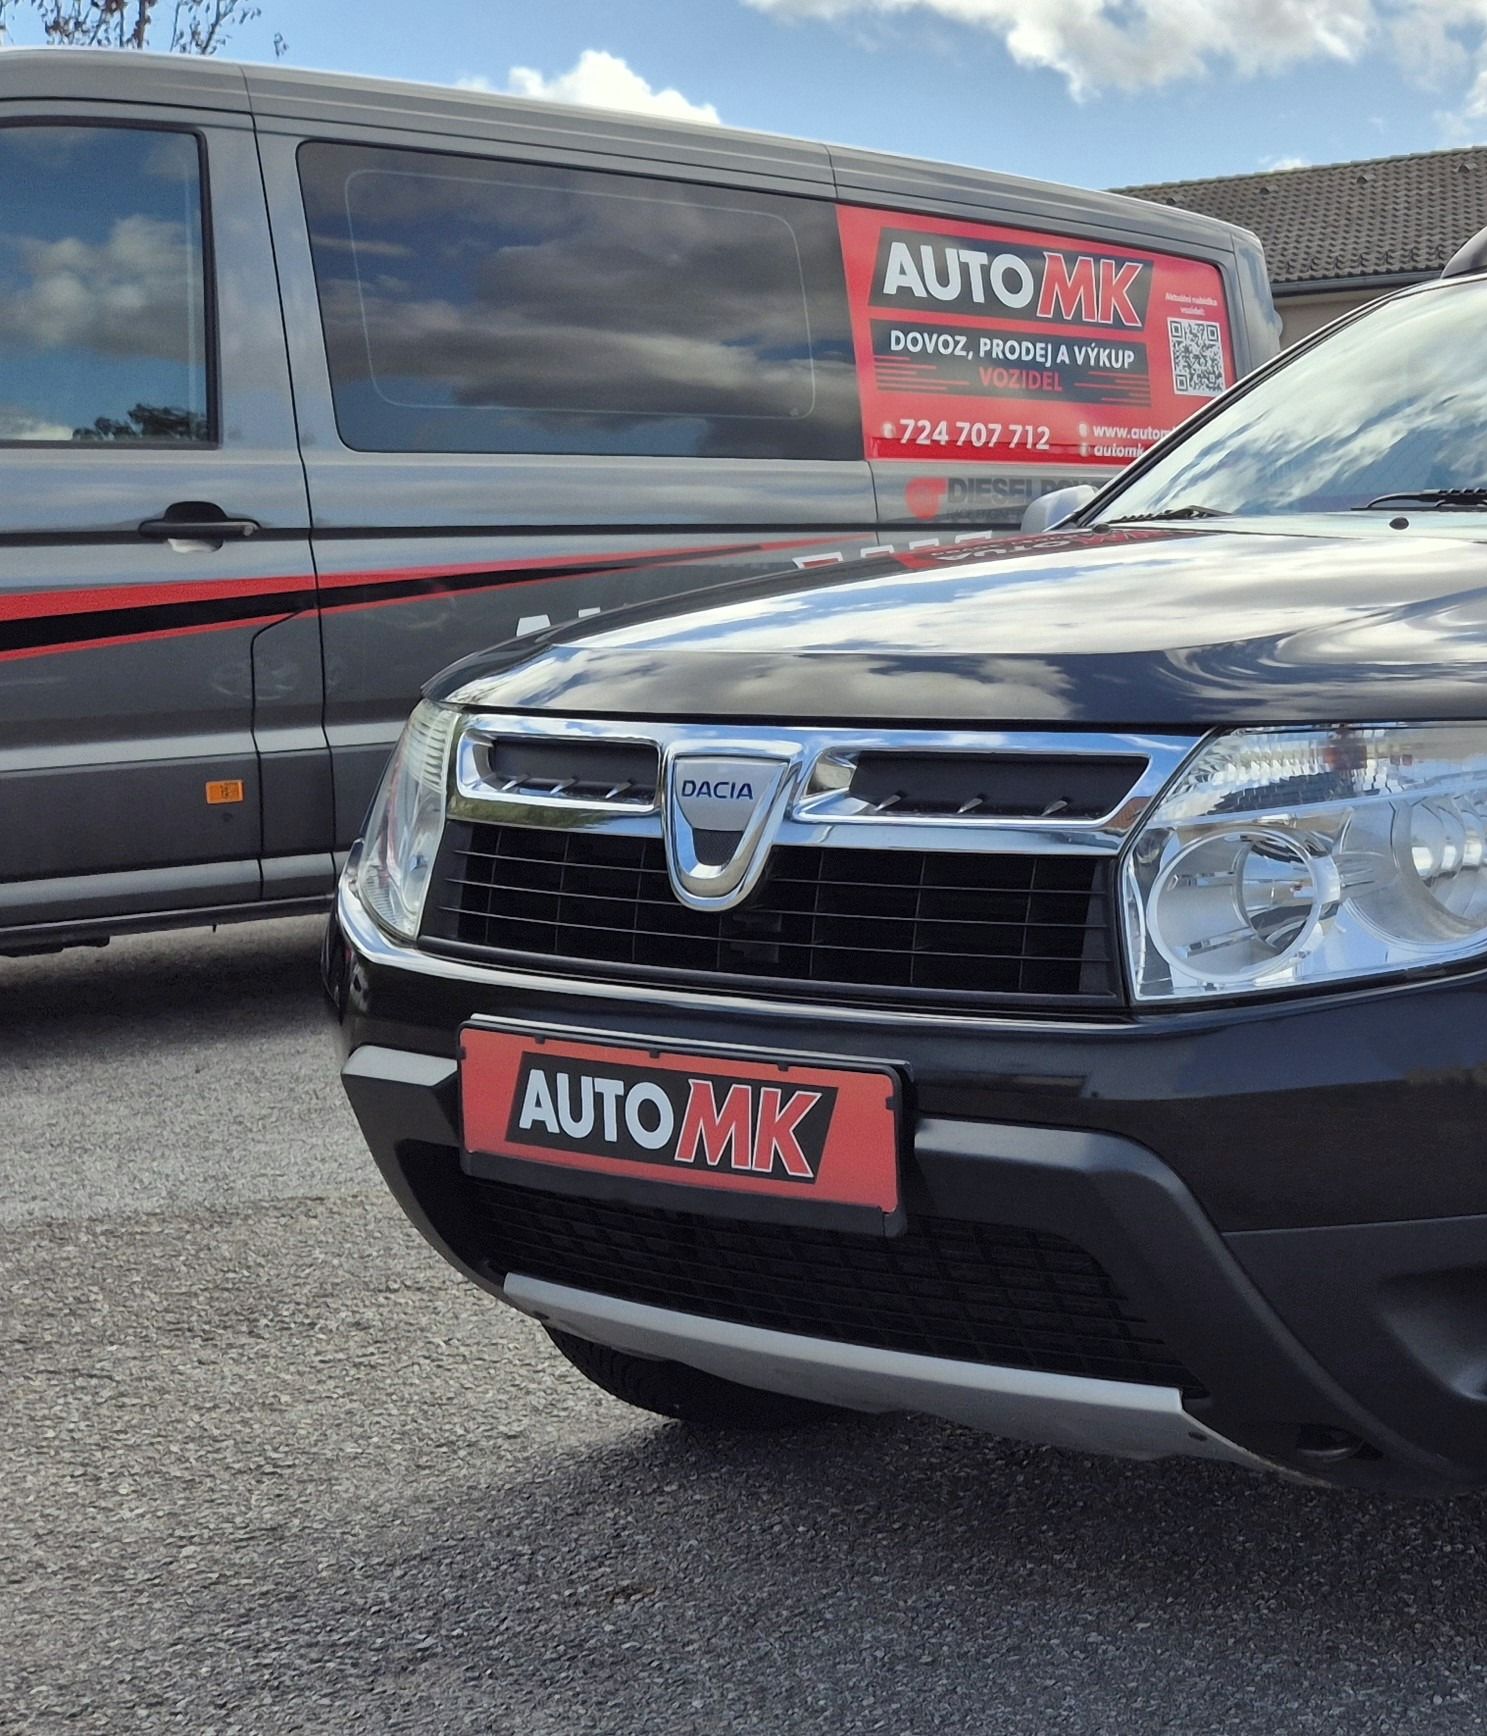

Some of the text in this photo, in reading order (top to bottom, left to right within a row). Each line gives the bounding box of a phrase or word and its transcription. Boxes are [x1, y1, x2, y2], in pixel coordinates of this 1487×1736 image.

[889, 330, 1136, 369] DOVOZ, PRODEJ A VÝKUP
[978, 366, 1064, 393] VOZIDEL
[899, 418, 1050, 451] 724 707 712
[1093, 425, 1177, 441] www.autom
[681, 780, 754, 800] DACIA
